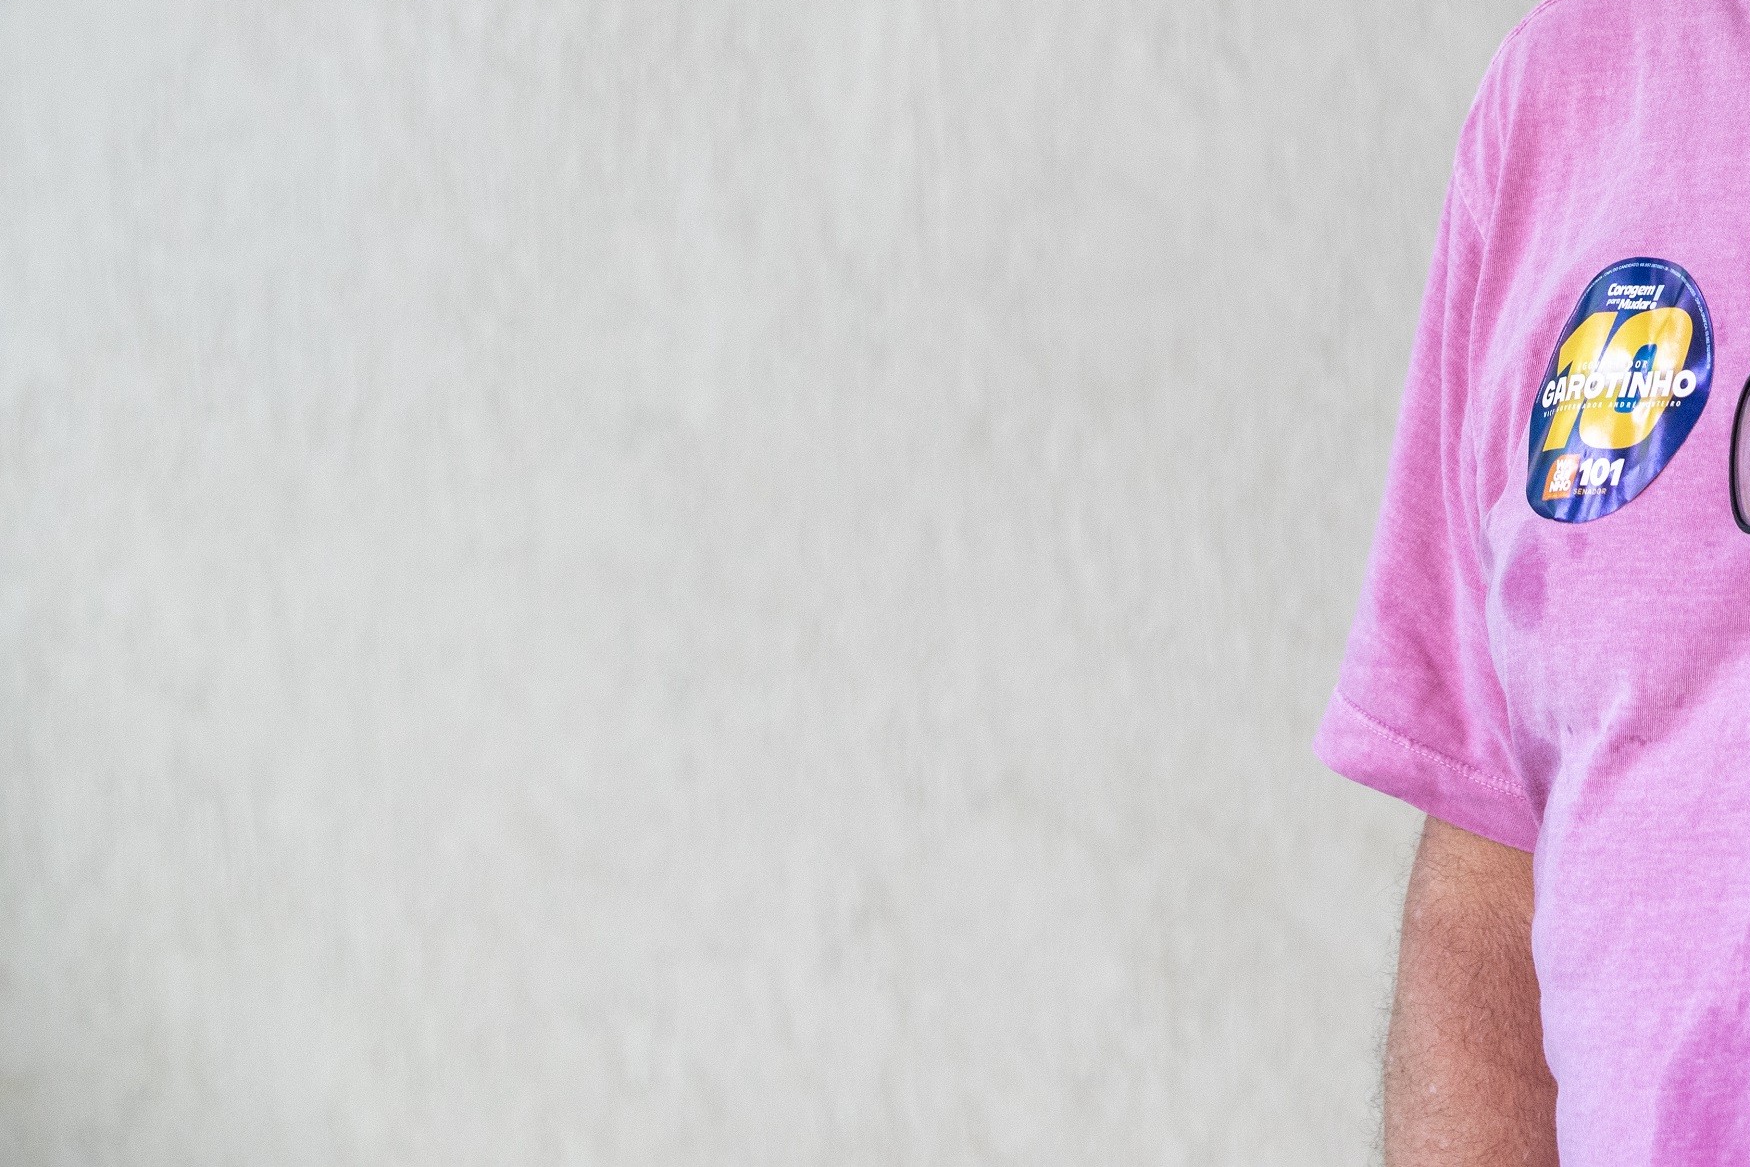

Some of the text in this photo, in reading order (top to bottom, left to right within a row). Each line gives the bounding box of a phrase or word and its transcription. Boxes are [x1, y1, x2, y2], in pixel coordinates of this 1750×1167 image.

[1542, 307, 1693, 451] 10
[1542, 369, 1696, 408] GAROTINHO
[1579, 458, 1625, 486] 101
